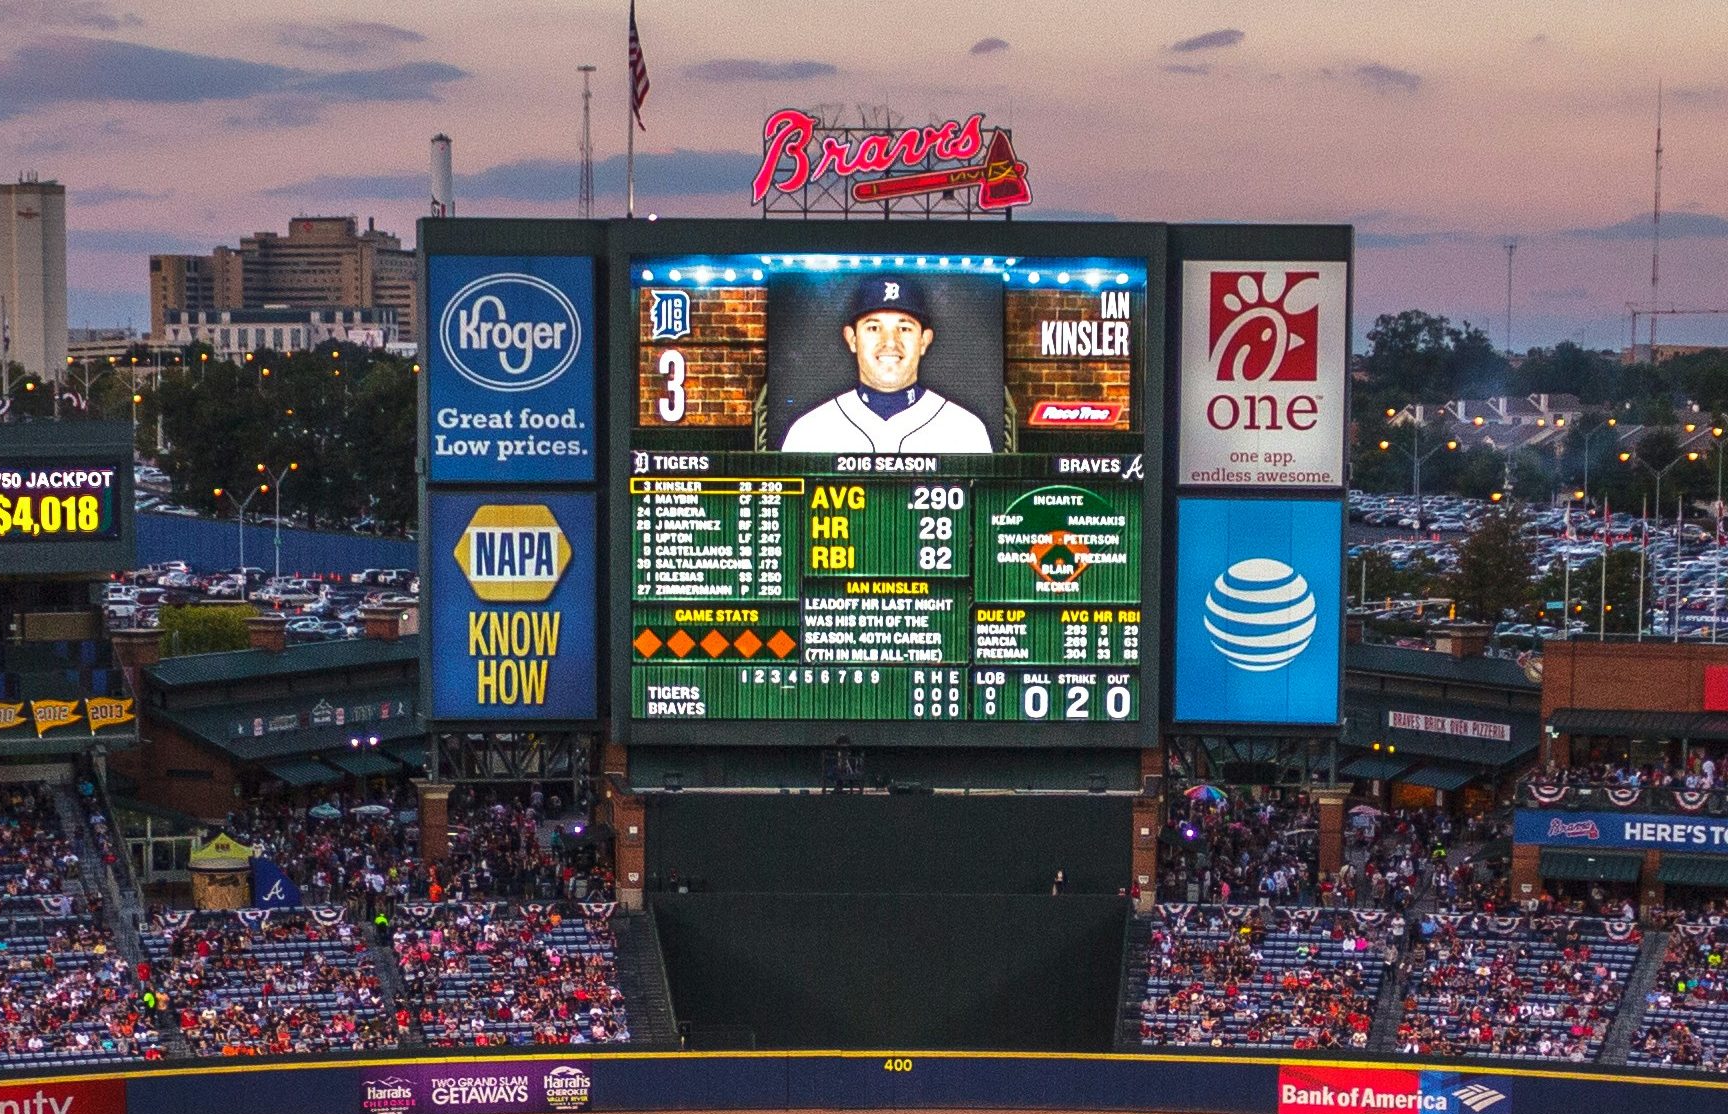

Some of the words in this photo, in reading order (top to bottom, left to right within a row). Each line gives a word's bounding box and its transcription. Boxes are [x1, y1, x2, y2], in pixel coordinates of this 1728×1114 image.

[752, 109, 986, 205] Braves
[1101, 292, 1130, 319] IAN
[459, 295, 566, 374] Kroger
[1042, 321, 1129, 356] KINSLER
[658, 351, 685, 422] 3
[437, 408, 513, 428] Great
[520, 408, 585, 428] food.
[1207, 394, 1318, 431] one
[436, 436, 490, 455] Low
[498, 436, 588, 461] prices.
[654, 456, 709, 470] TIGERS
[837, 457, 871, 471] 2016
[875, 456, 936, 471] SEASON
[1060, 459, 1121, 473] BRAVES
[1230, 451, 1258, 462] one
[1264, 452, 1296, 465] app.
[25, 471, 113, 488] JACKPOT
[1192, 468, 1251, 482] endless
[1257, 471, 1334, 483] awesome.
[643, 482, 650, 491] 3
[655, 482, 701, 491] KINSLER
[811, 486, 865, 509] AVG
[908, 488, 964, 510] .290
[1034, 496, 1083, 505] INCIARTE
[811, 516, 848, 539] HR
[920, 517, 951, 540] 28
[992, 516, 1023, 525] KEMP
[1068, 516, 1125, 526] MARKAKIS
[656, 534, 692, 543] UPTON
[1063, 534, 1119, 544] PETERSON
[476, 532, 553, 576] NAPA
[811, 546, 855, 569] RBI
[920, 547, 951, 569] 82
[656, 572, 704, 582] IGLESIAS
[656, 585, 732, 595] ZIMMERMANN
[675, 610, 713, 622] GAME
[716, 610, 758, 622] STATS
[977, 610, 1003, 621] DUE
[1007, 610, 1025, 621] UP
[469, 612, 560, 656] KNOW
[477, 660, 548, 704] HOW
[976, 672, 1005, 684] LOB
[1024, 675, 1051, 684] BALL
[1058, 674, 1096, 684] STRIKE
[1107, 675, 1130, 684] OUT
[648, 687, 699, 700] TIGERS
[1024, 686, 1048, 718] 0
[1066, 686, 1089, 718] 2
[1106, 686, 1131, 718] 0
[90, 703, 123, 720] 2013
[648, 703, 706, 715] BRAVES
[1624, 822, 1706, 844] HERE'S
[884, 1059, 913, 1072] 400
[432, 1078, 456, 1088] TWO
[458, 1077, 497, 1087] GRAND
[500, 1076, 528, 1085] SLAM
[432, 1086, 528, 1104] GETAWAYS
[1282, 1084, 1332, 1107] Bank
[1338, 1088, 1358, 1109] of
[1361, 1089, 1448, 1111] America
